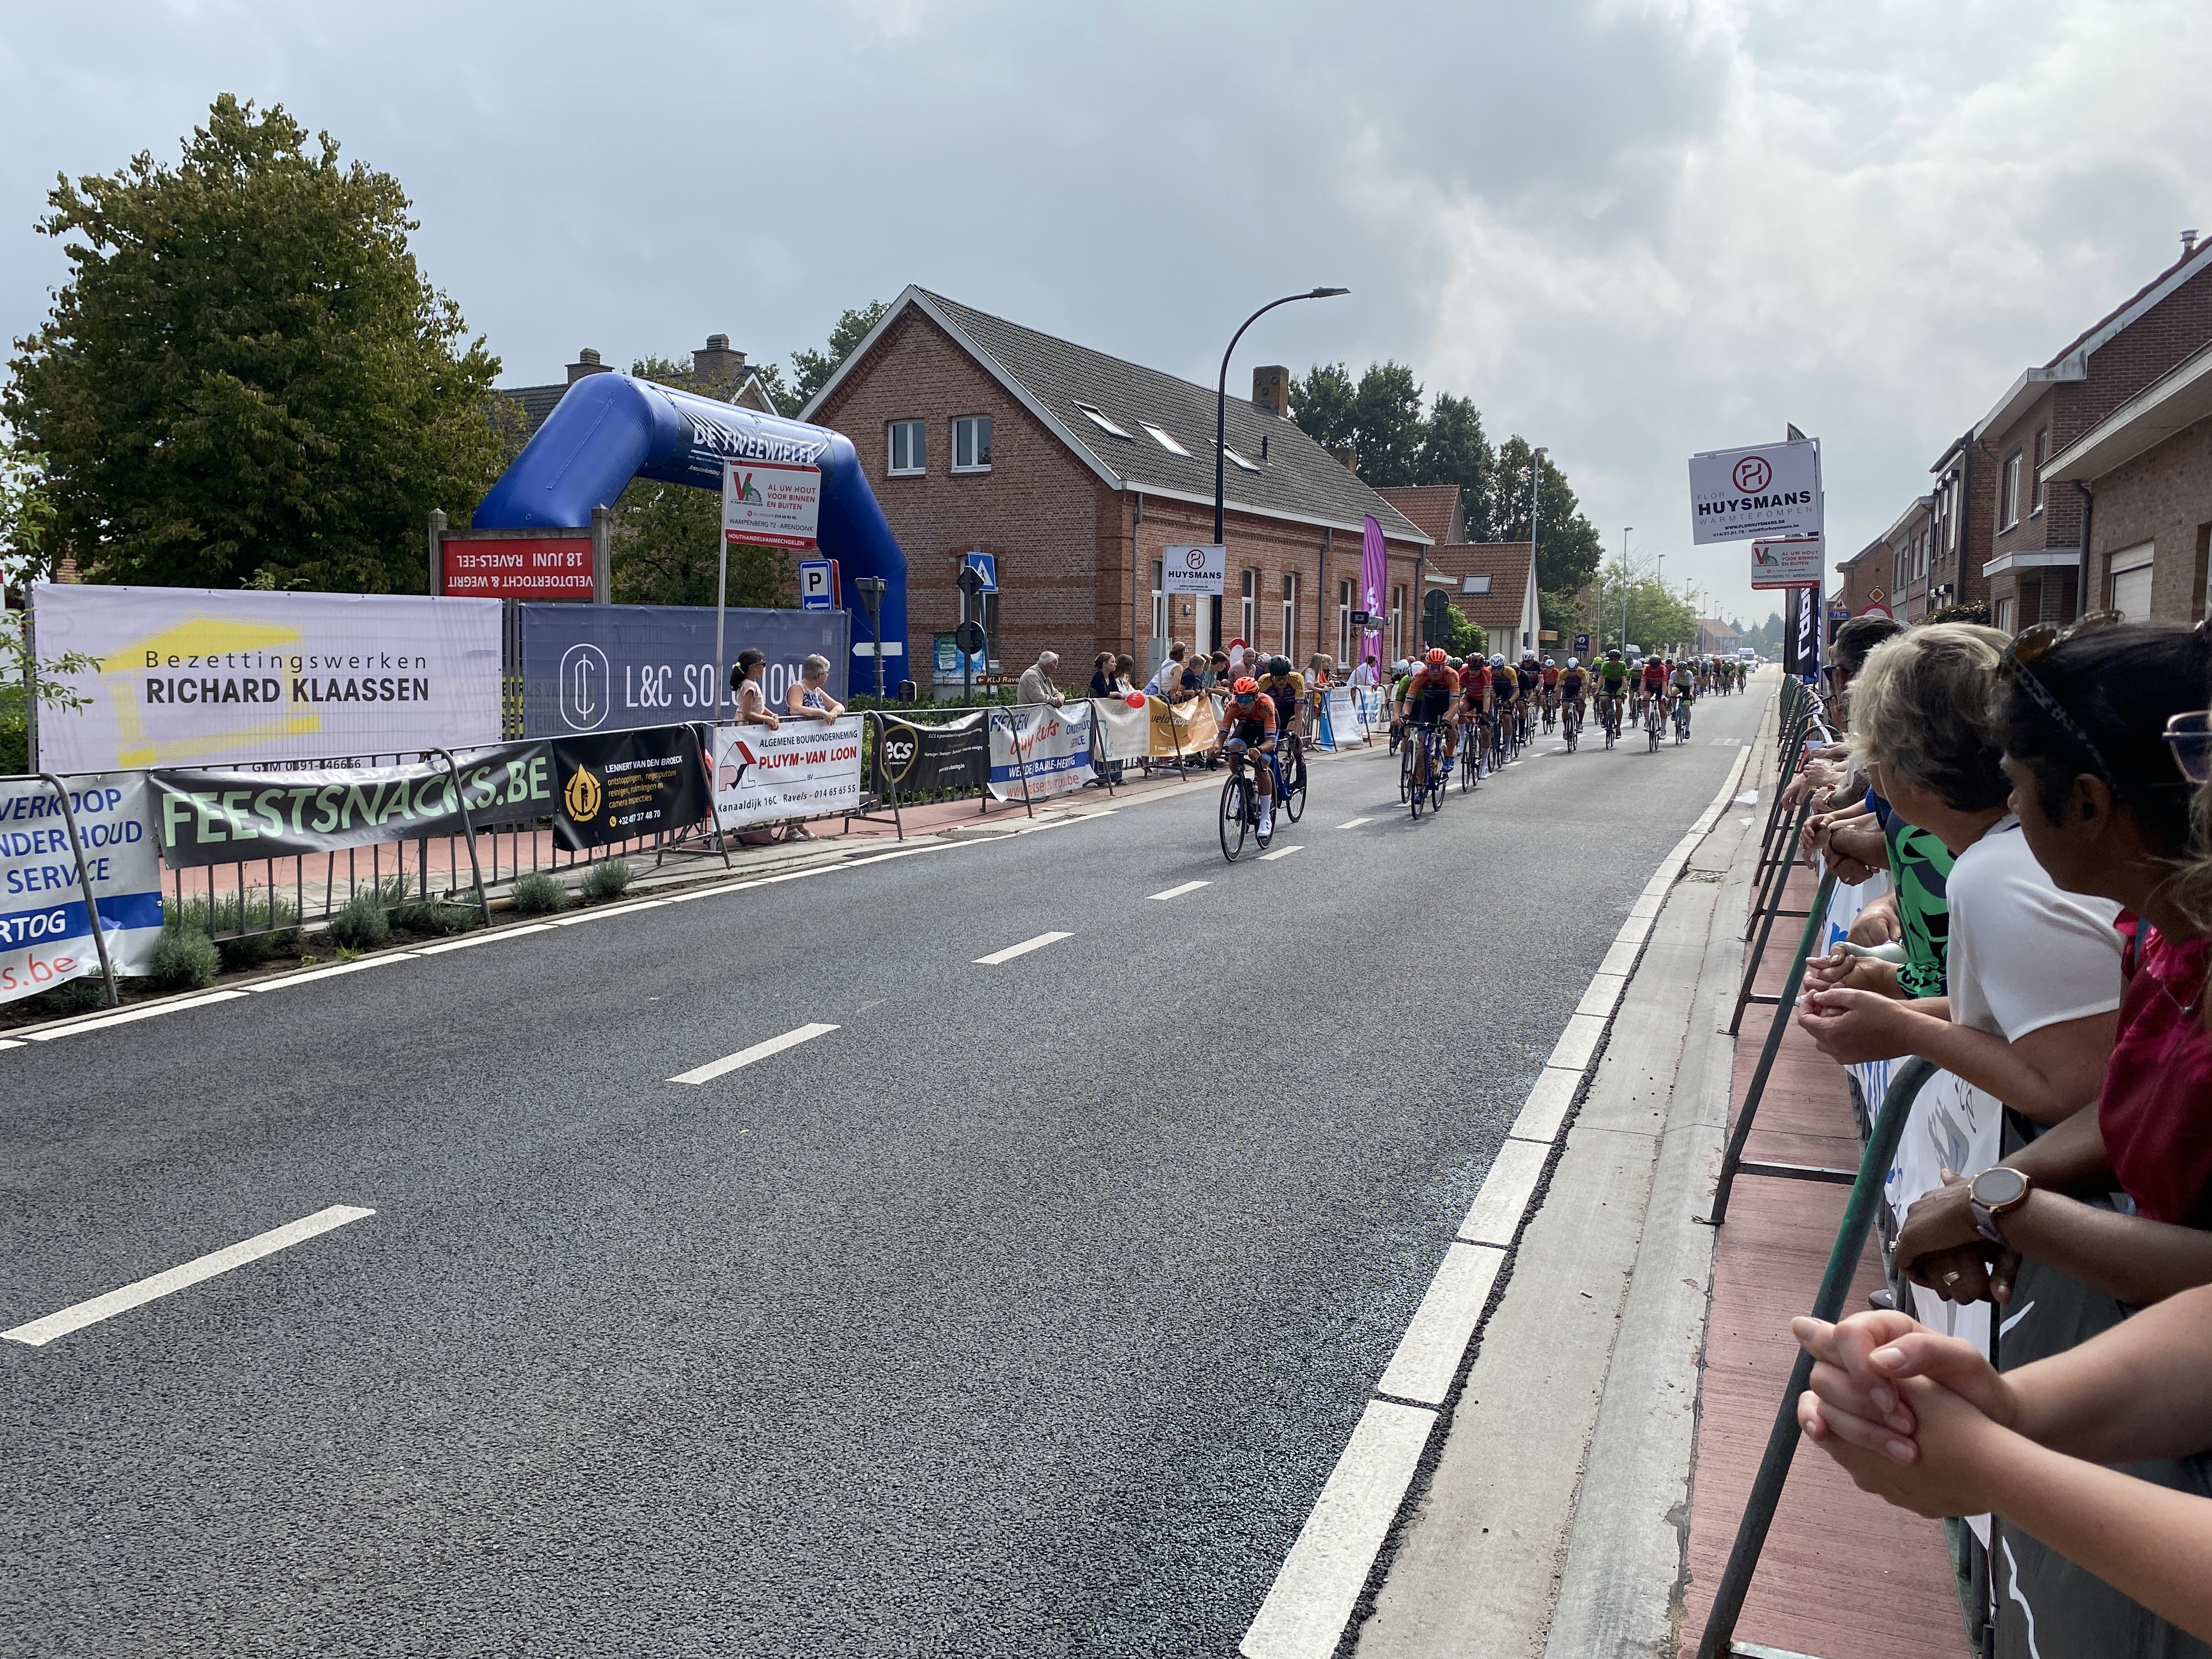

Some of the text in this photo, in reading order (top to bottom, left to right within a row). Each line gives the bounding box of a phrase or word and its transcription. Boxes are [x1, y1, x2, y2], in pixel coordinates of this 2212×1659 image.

[693, 425, 815, 464] DE TWEEWIELER
[768, 493, 816, 503] VOOR BINNEN
[795, 486, 816, 494] HOUT
[1697, 491, 1725, 501] FLOR
[1699, 490, 1812, 516] HUYSMANS
[1700, 505, 1813, 525] WARMTEPOMPEN
[729, 518, 769, 527] WAMPENBERG
[780, 523, 814, 532] ARENDONK
[456, 552, 583, 568] 18 JUNI RAVELS-EEL
[448, 575, 594, 588] VELDTOERTOCHT & WEGRIT
[808, 572, 822, 592] P
[1168, 571, 1222, 579] HUYSMANS
[145, 650, 428, 673] Bezettingswerken
[146, 677, 430, 704] RICHARD KLAASSEN
[626, 664, 672, 708] L&C
[759, 730, 857, 748] ALGEMENE BOUWONDERNEMING
[758, 746, 857, 770] PLUYM-VAN LOON
[886, 741, 913, 759] ecs
[605, 755, 683, 773] LENNERT VAN DEN BROECK
[608, 787, 630, 798] reinigen,
[608, 794, 652, 809] camera inspecties
[718, 798, 761, 813] Kanaaldijk
[764, 795, 777, 806] 16C
[783, 791, 808, 803] Ravels
[814, 788, 827, 798] 014
[829, 787, 837, 796] 65
[838, 786, 847, 795] 65
[848, 784, 856, 793] 55
[163, 757, 550, 847] FEESTSNACKS.BE
[618, 816, 629, 825] +32
[637, 812, 644, 821] 37
[645, 811, 653, 820] 48
[653, 809, 661, 818] 70
